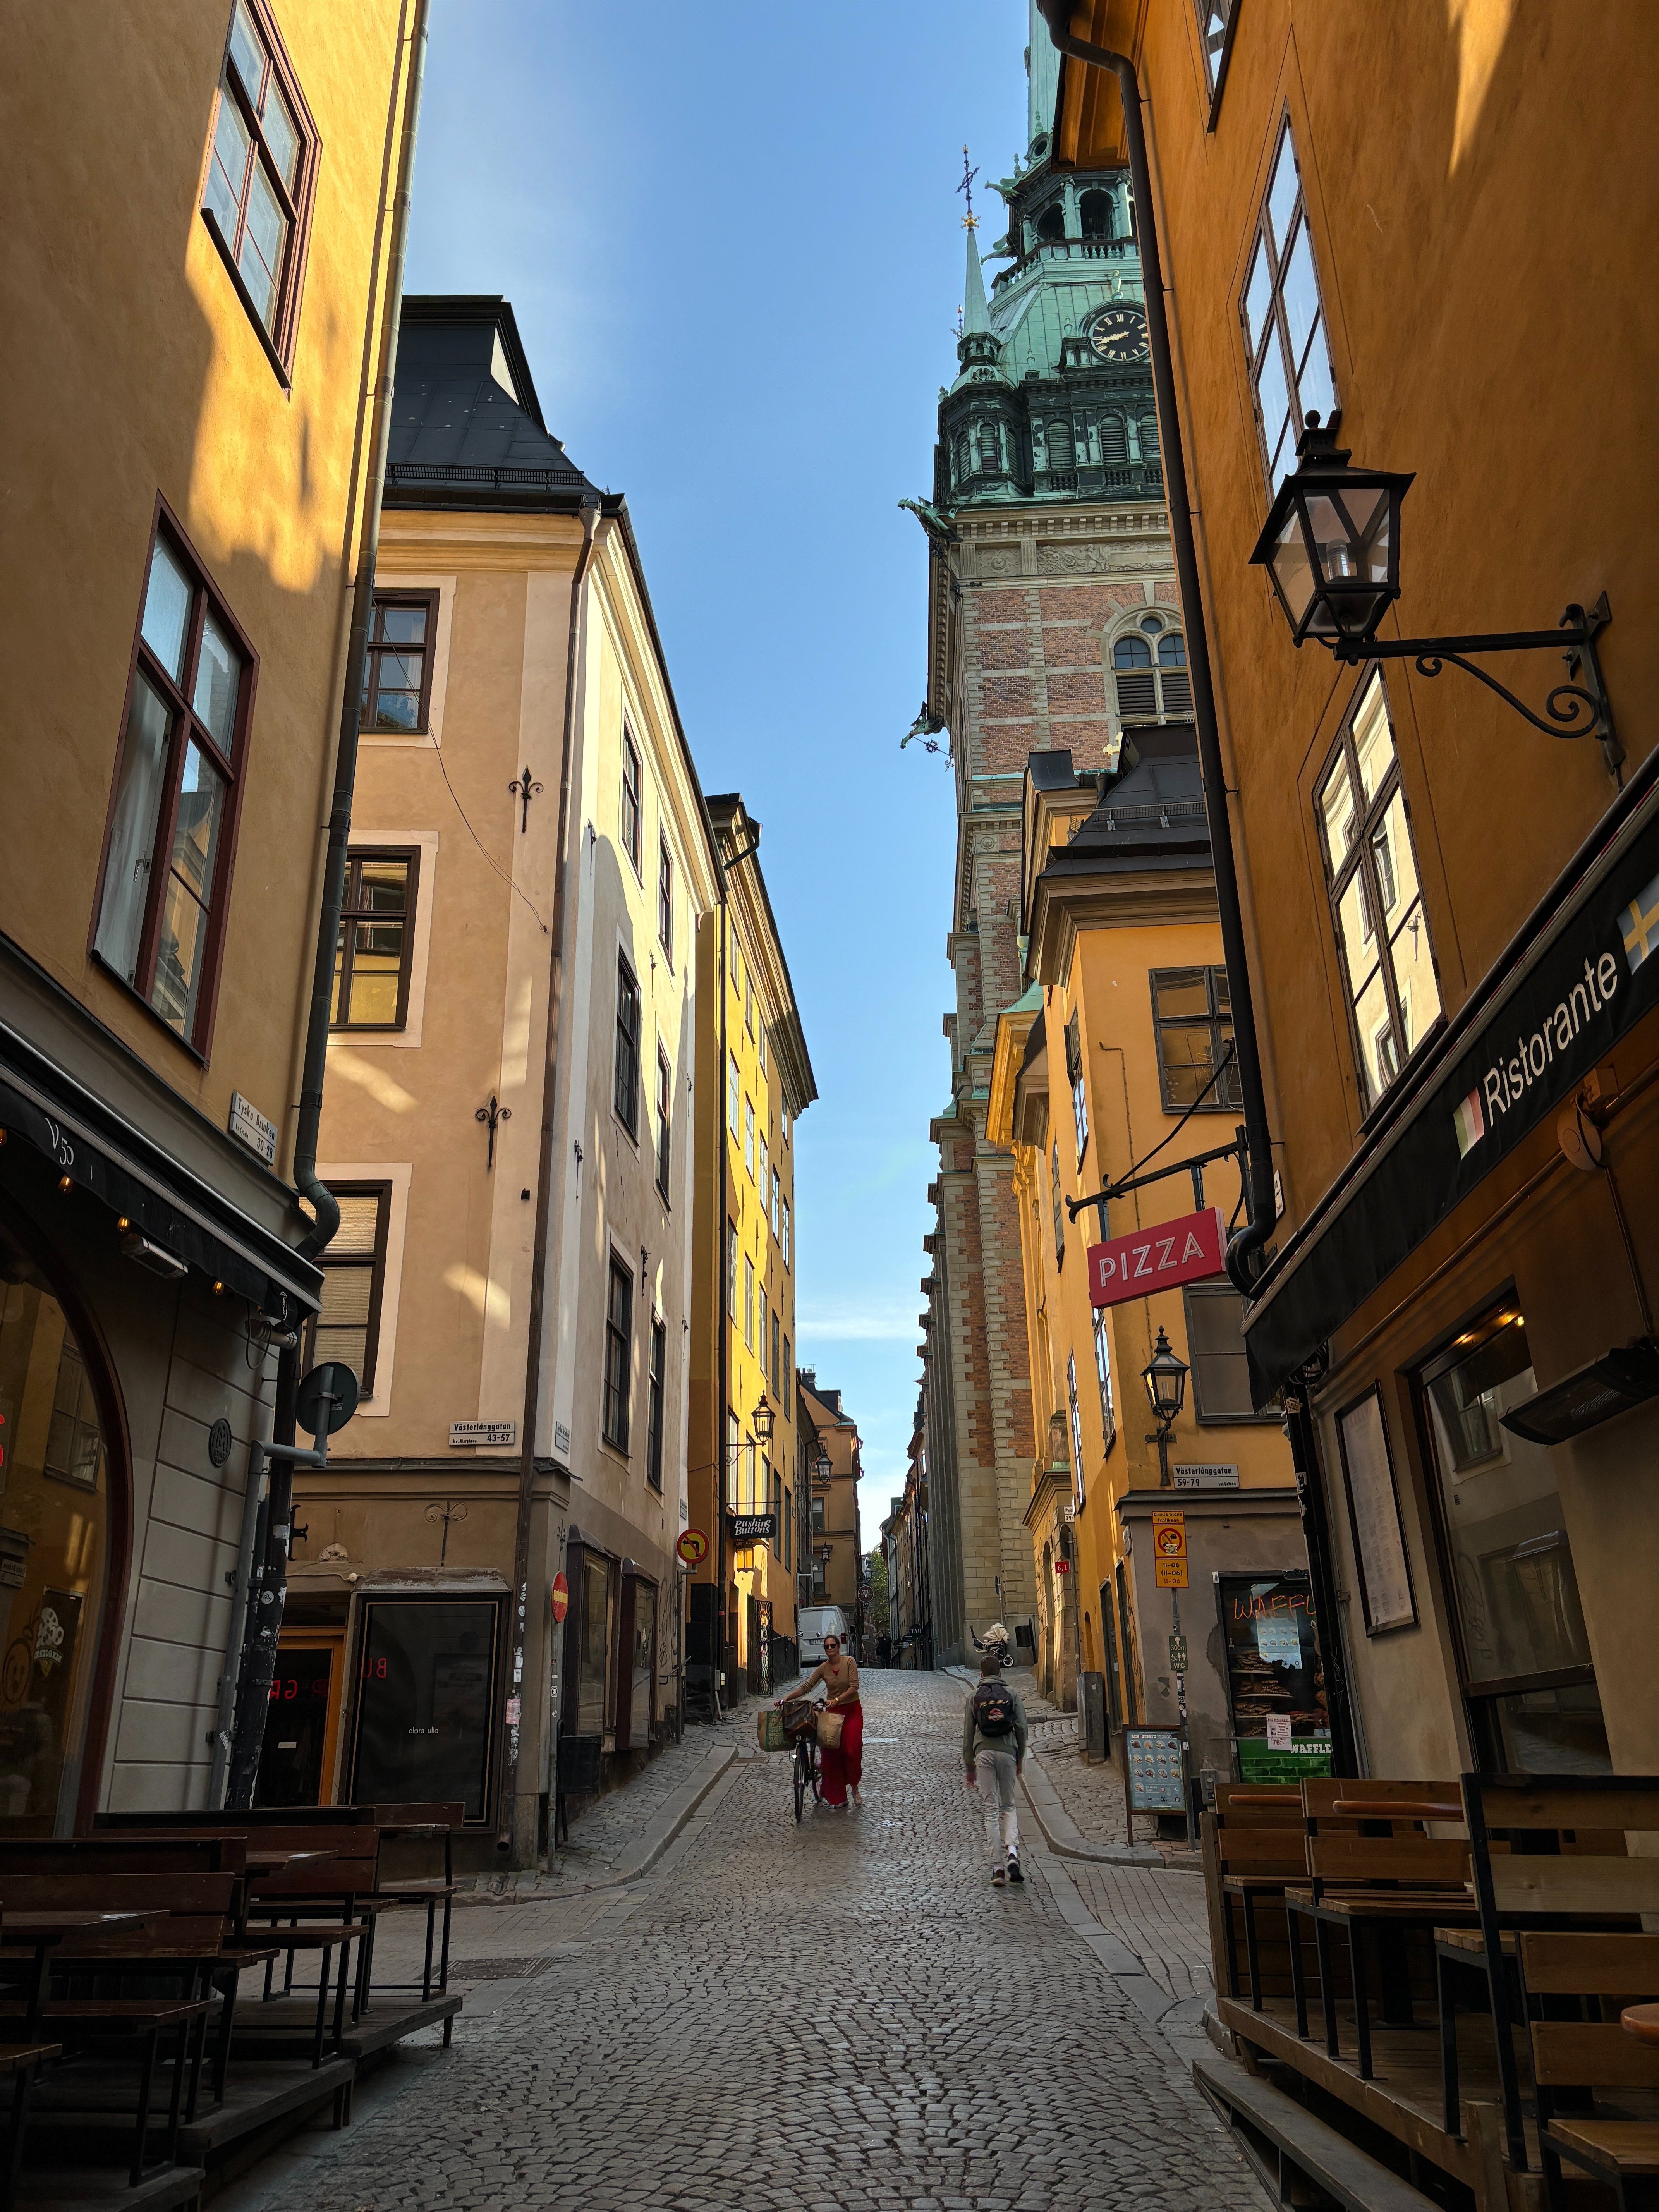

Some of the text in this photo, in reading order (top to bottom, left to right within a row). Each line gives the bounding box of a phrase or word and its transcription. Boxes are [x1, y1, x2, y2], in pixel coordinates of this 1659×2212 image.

[1483, 952, 1618, 1127] Ristorante
[239, 1098, 275, 1140] Tyska Brinken
[257, 1137, 273, 1159] 30-28
[1099, 1231, 1205, 1288] PIZZA
[454, 1423, 510, 1431] Västerlånggatan
[487, 1434, 510, 1442] 43-57
[1176, 1467, 1232, 1475] Västerlånggatan
[734, 1518, 771, 1529] Pushing
[735, 1526, 770, 1535] Buttons
[428, 1726, 439, 1734] ulla
